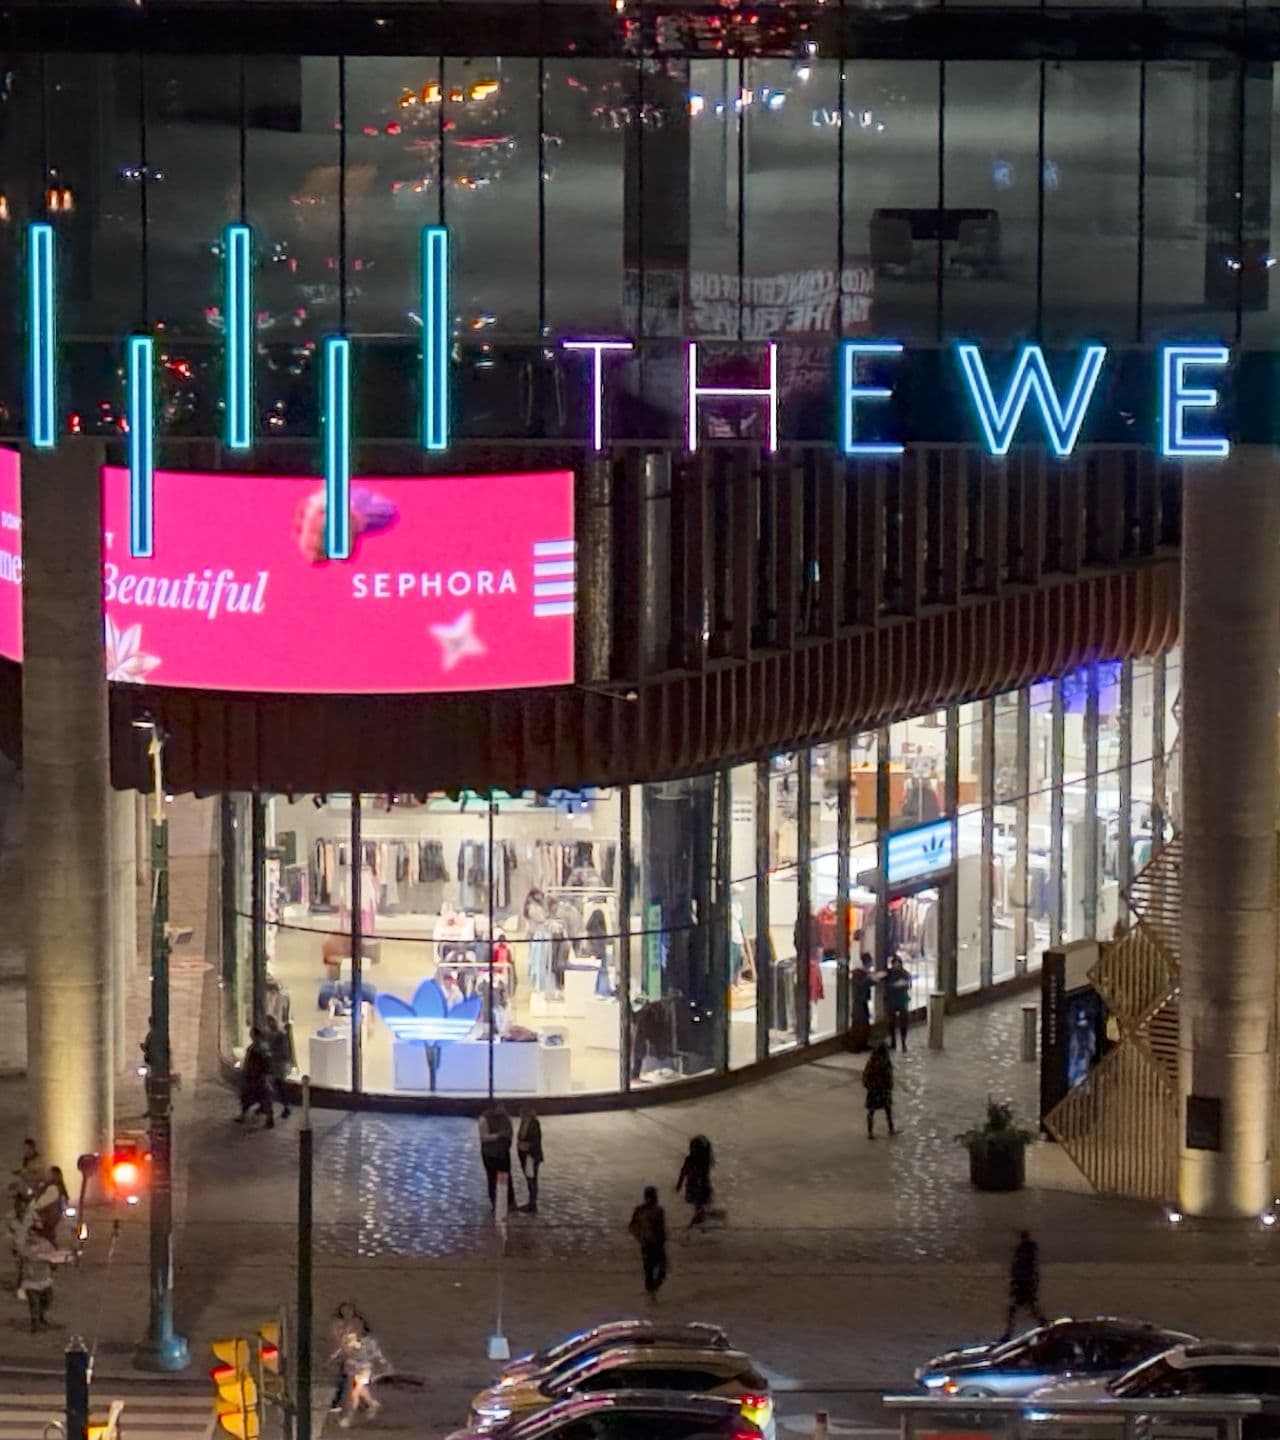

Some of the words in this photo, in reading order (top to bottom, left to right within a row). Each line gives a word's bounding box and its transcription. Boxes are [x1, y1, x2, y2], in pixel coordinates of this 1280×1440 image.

[563, 340, 905, 454] THE
[104, 562, 269, 620] Beautiful
[352, 569, 518, 598] SEPHORA
